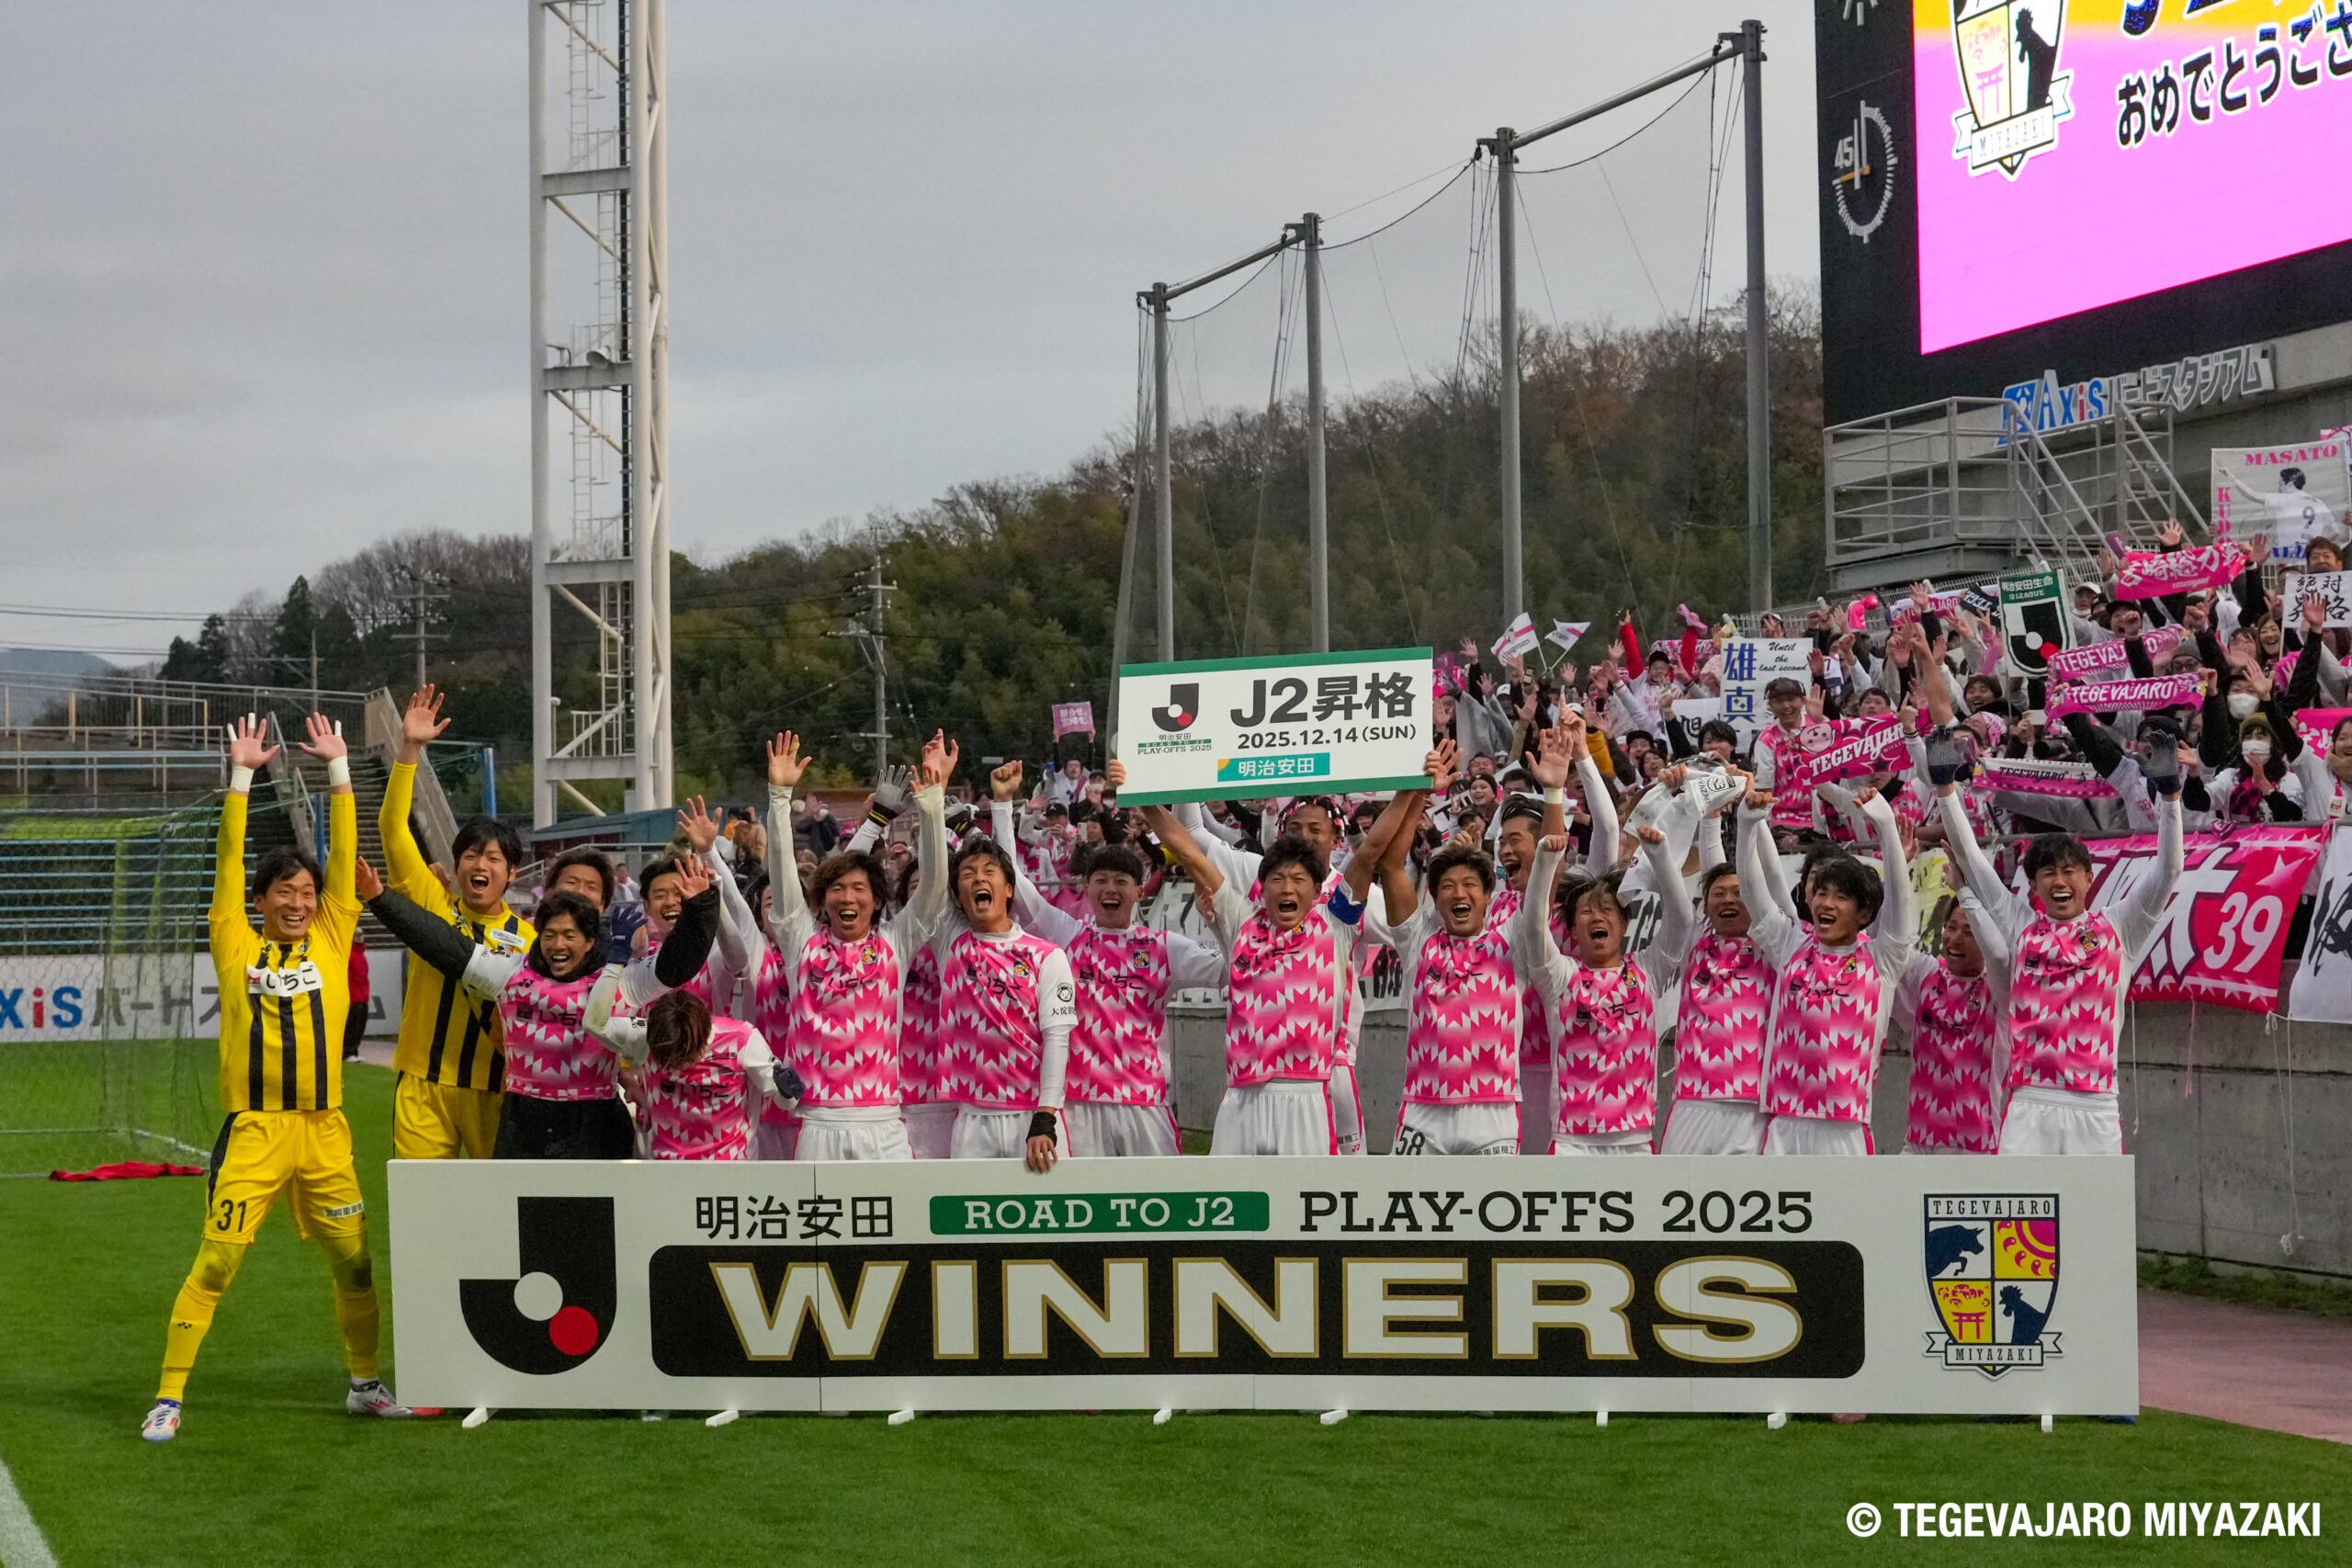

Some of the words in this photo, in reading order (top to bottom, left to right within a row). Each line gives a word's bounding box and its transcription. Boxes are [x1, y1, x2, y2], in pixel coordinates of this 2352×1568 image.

[1835, 137, 1854, 168] 45
[2245, 446, 2338, 466] MASATO
[2296, 575, 2343, 593] 絶対
[1769, 641, 1796, 651] Until
[2056, 637, 2158, 672] TEGEVAJO
[1775, 654, 1789, 662] the
[1779, 663, 1808, 671] second
[1724, 643, 1758, 723] 雄真
[2071, 681, 2174, 704] TEGEVAJARO
[1230, 671, 1416, 728] J2昇格
[1238, 723, 1416, 750] 2025.12.14(SUN)
[1138, 745, 1186, 754] PLAY-OFFS
[1810, 722, 1905, 777] TEGEVAJAR
[1238, 757, 1315, 777] 明治安田
[1999, 766, 2065, 783] TEGEVAJARO
[2203, 892, 2283, 974] 39
[1255, 942, 1301, 964] いちご
[266, 964, 316, 990] いちご
[1098, 969, 1145, 990] いちご
[539, 1010, 582, 1026] いち
[681, 1082, 729, 1099] いちご
[1396, 1125, 1425, 1156] 58
[217, 1199, 247, 1233] 31
[695, 1195, 893, 1240] 明治安田
[965, 1200, 1093, 1229] ROAD
[1113, 1199, 1170, 1227] TO
[1188, 1197, 1236, 1227] J2
[1300, 1190, 1634, 1233] PLAY-OFFS
[1661, 1190, 1813, 1233] 2025
[1933, 1200, 2052, 1218] TEGEVAJARO
[708, 1255, 1803, 1363] WINNERS
[1955, 1348, 2033, 1360] MIYAZAKI
